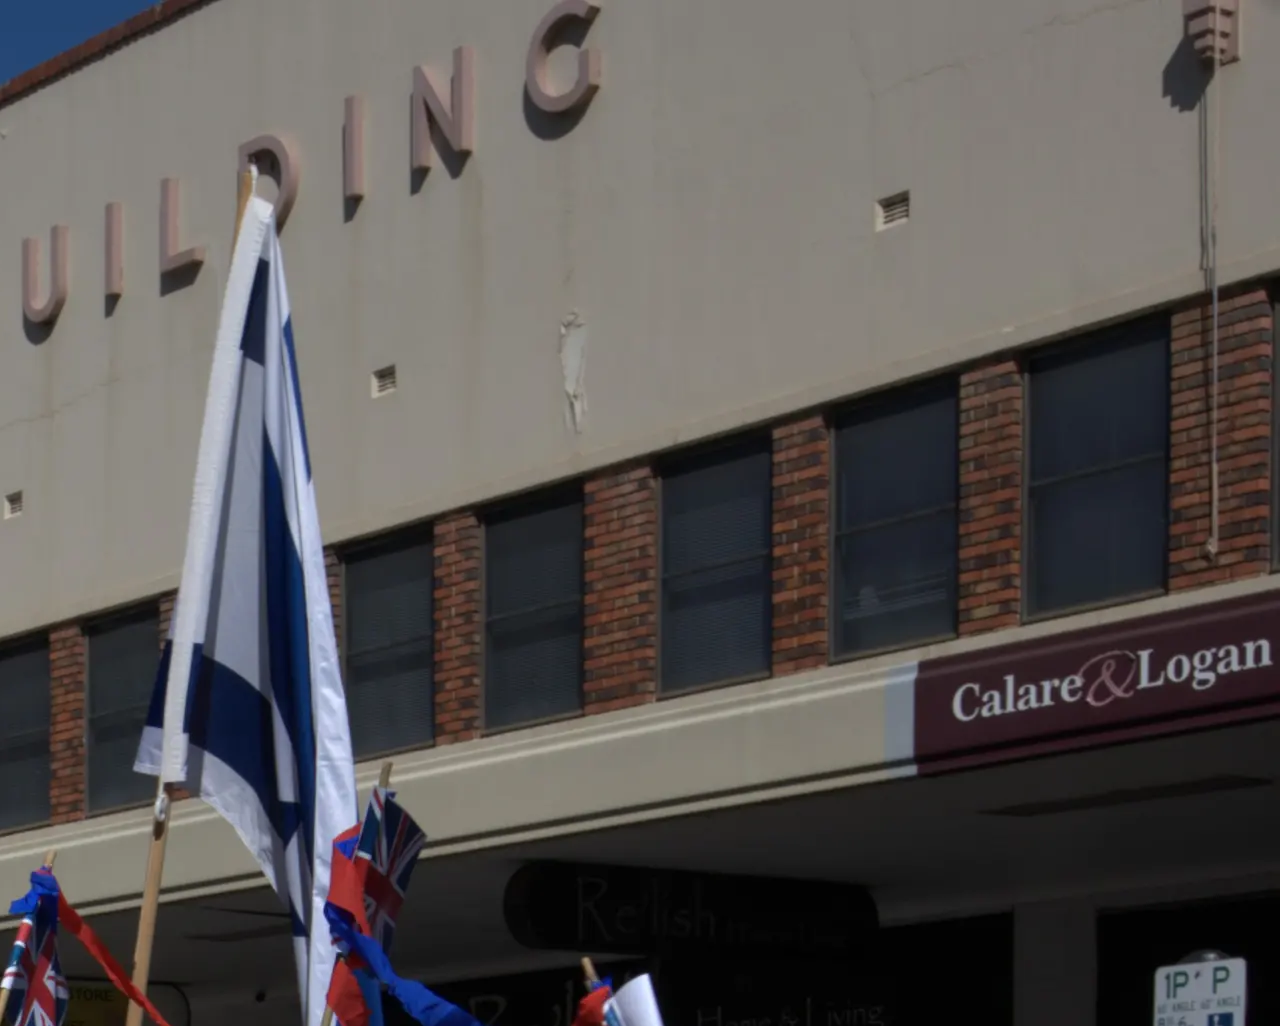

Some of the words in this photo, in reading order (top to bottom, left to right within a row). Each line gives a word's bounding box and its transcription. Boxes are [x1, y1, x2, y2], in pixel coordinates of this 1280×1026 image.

[951, 674, 1084, 722] Calare
[1077, 649, 1137, 706] &
[1136, 638, 1273, 690] Logan
[1165, 970, 1189, 999] 1P
[1212, 966, 1230, 995] P
